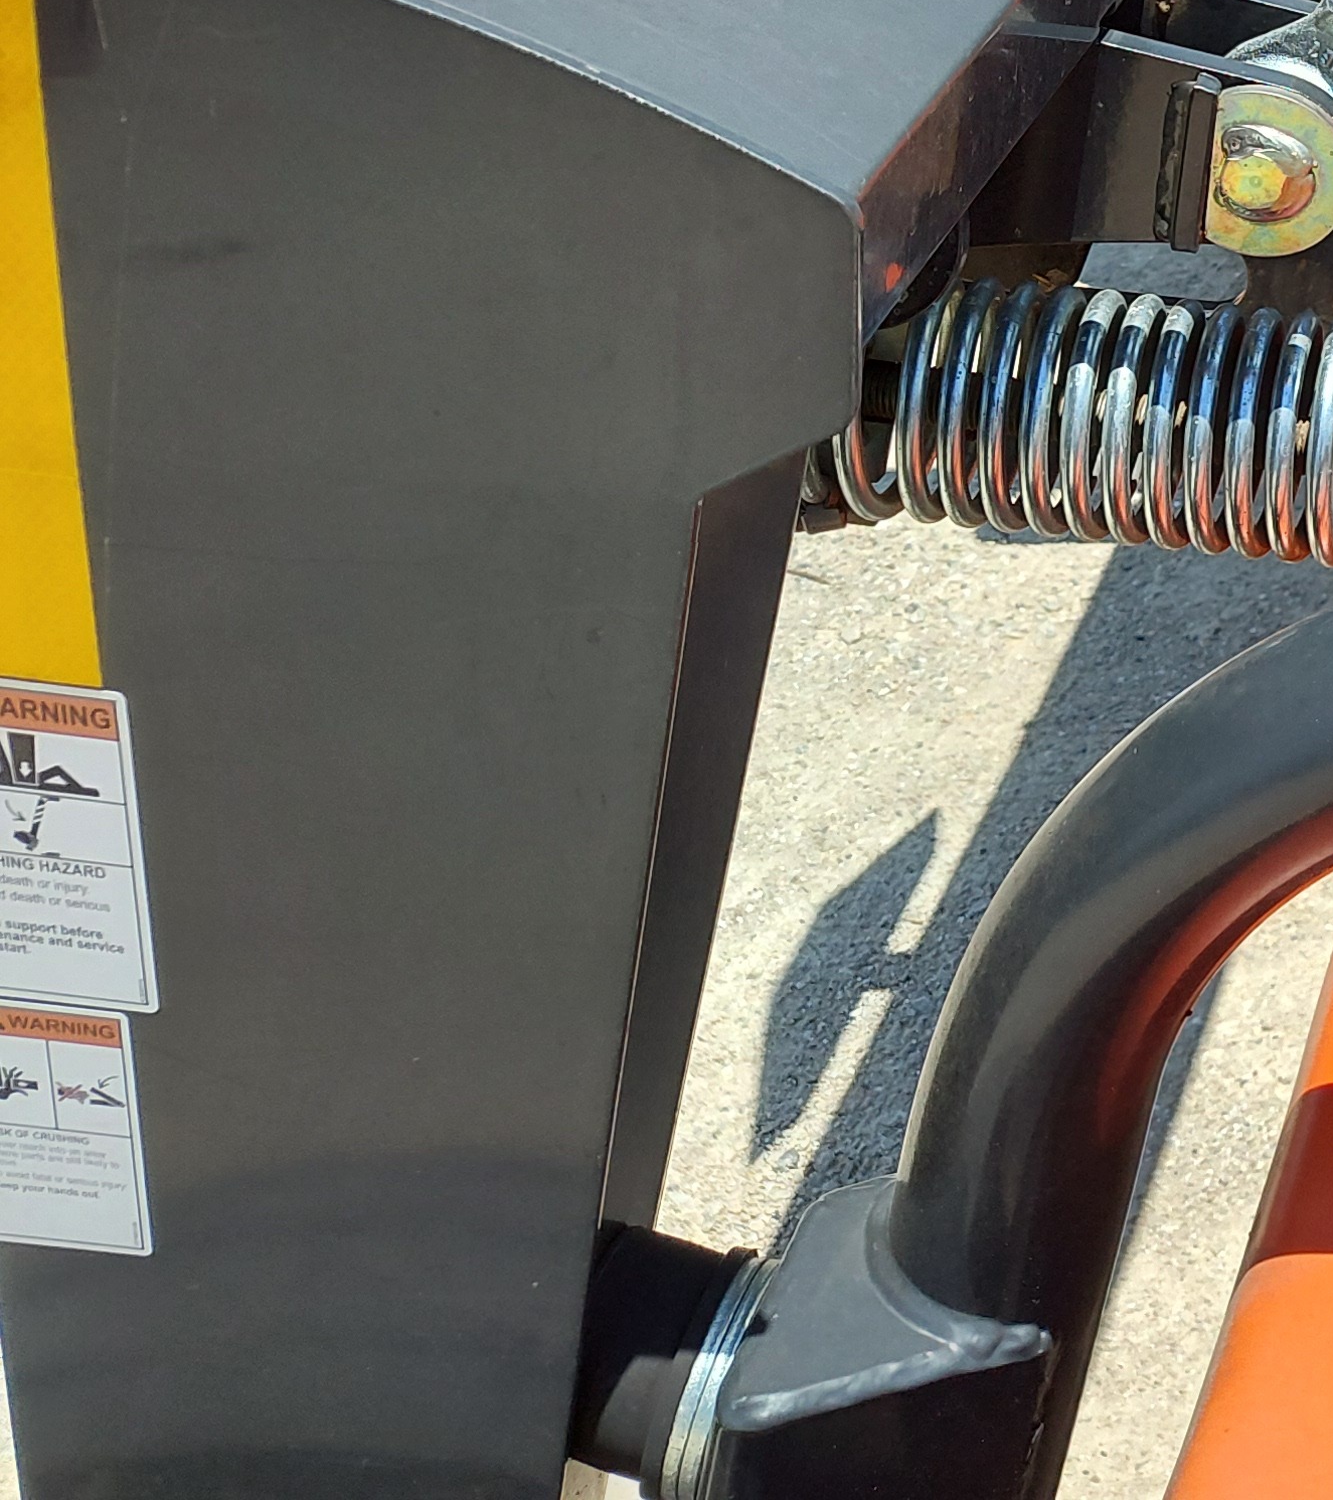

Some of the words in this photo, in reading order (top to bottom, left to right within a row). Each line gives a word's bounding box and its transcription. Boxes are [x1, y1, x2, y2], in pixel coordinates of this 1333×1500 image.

[39, 859, 106, 879] HAZARD
[5, 920, 57, 934] support
[60, 924, 103, 940] before
[48, 937, 73, 948] and
[77, 942, 125, 954] service
[7, 1014, 115, 1039] WARNING
[32, 1131, 90, 1145] CRUSHING
